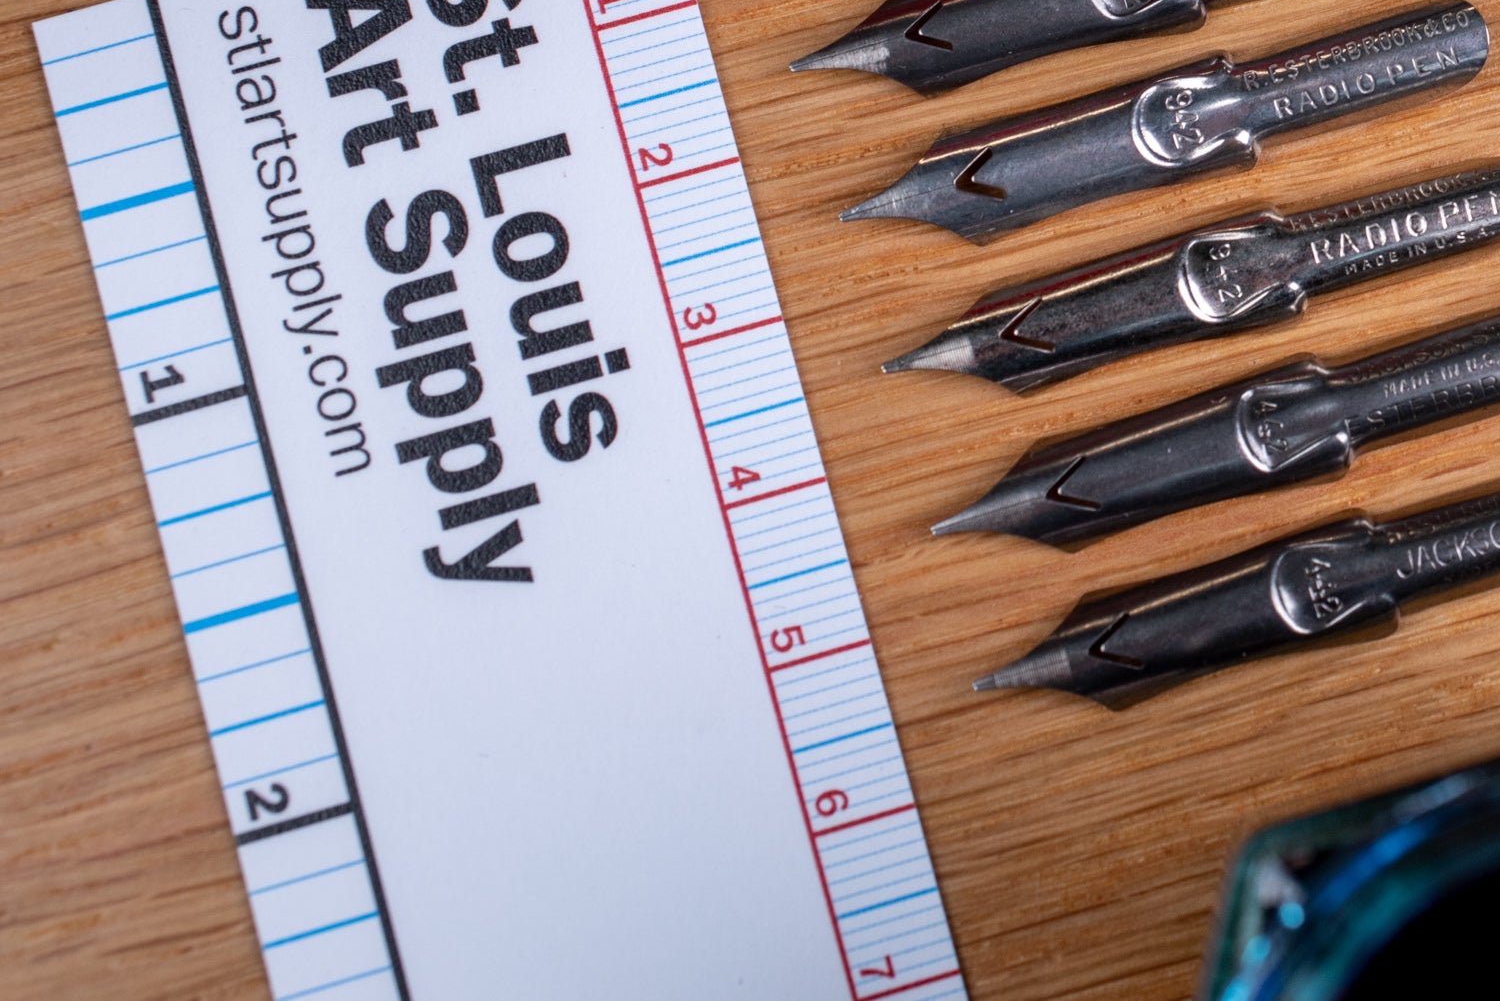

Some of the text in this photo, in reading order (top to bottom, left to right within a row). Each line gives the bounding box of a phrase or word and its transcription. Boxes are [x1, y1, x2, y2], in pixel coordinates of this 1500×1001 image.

[1273, 46, 1461, 120] RADIO PEN
[638, 142, 674, 172] 2
[217, 5, 372, 478] stlartsupply.com
[1310, 212, 1428, 265] RADIO
[1344, 249, 1399, 277] MADE
[1408, 242, 1427, 259] IN
[469, 131, 632, 463] Louis
[683, 302, 718, 331] 3
[139, 364, 185, 404] 1
[364, 189, 541, 583] Supply
[727, 465, 761, 491] 4
[770, 625, 806, 653] 5
[243, 783, 290, 822] 2
[814, 788, 849, 817] 6
[859, 955, 896, 980] 7
